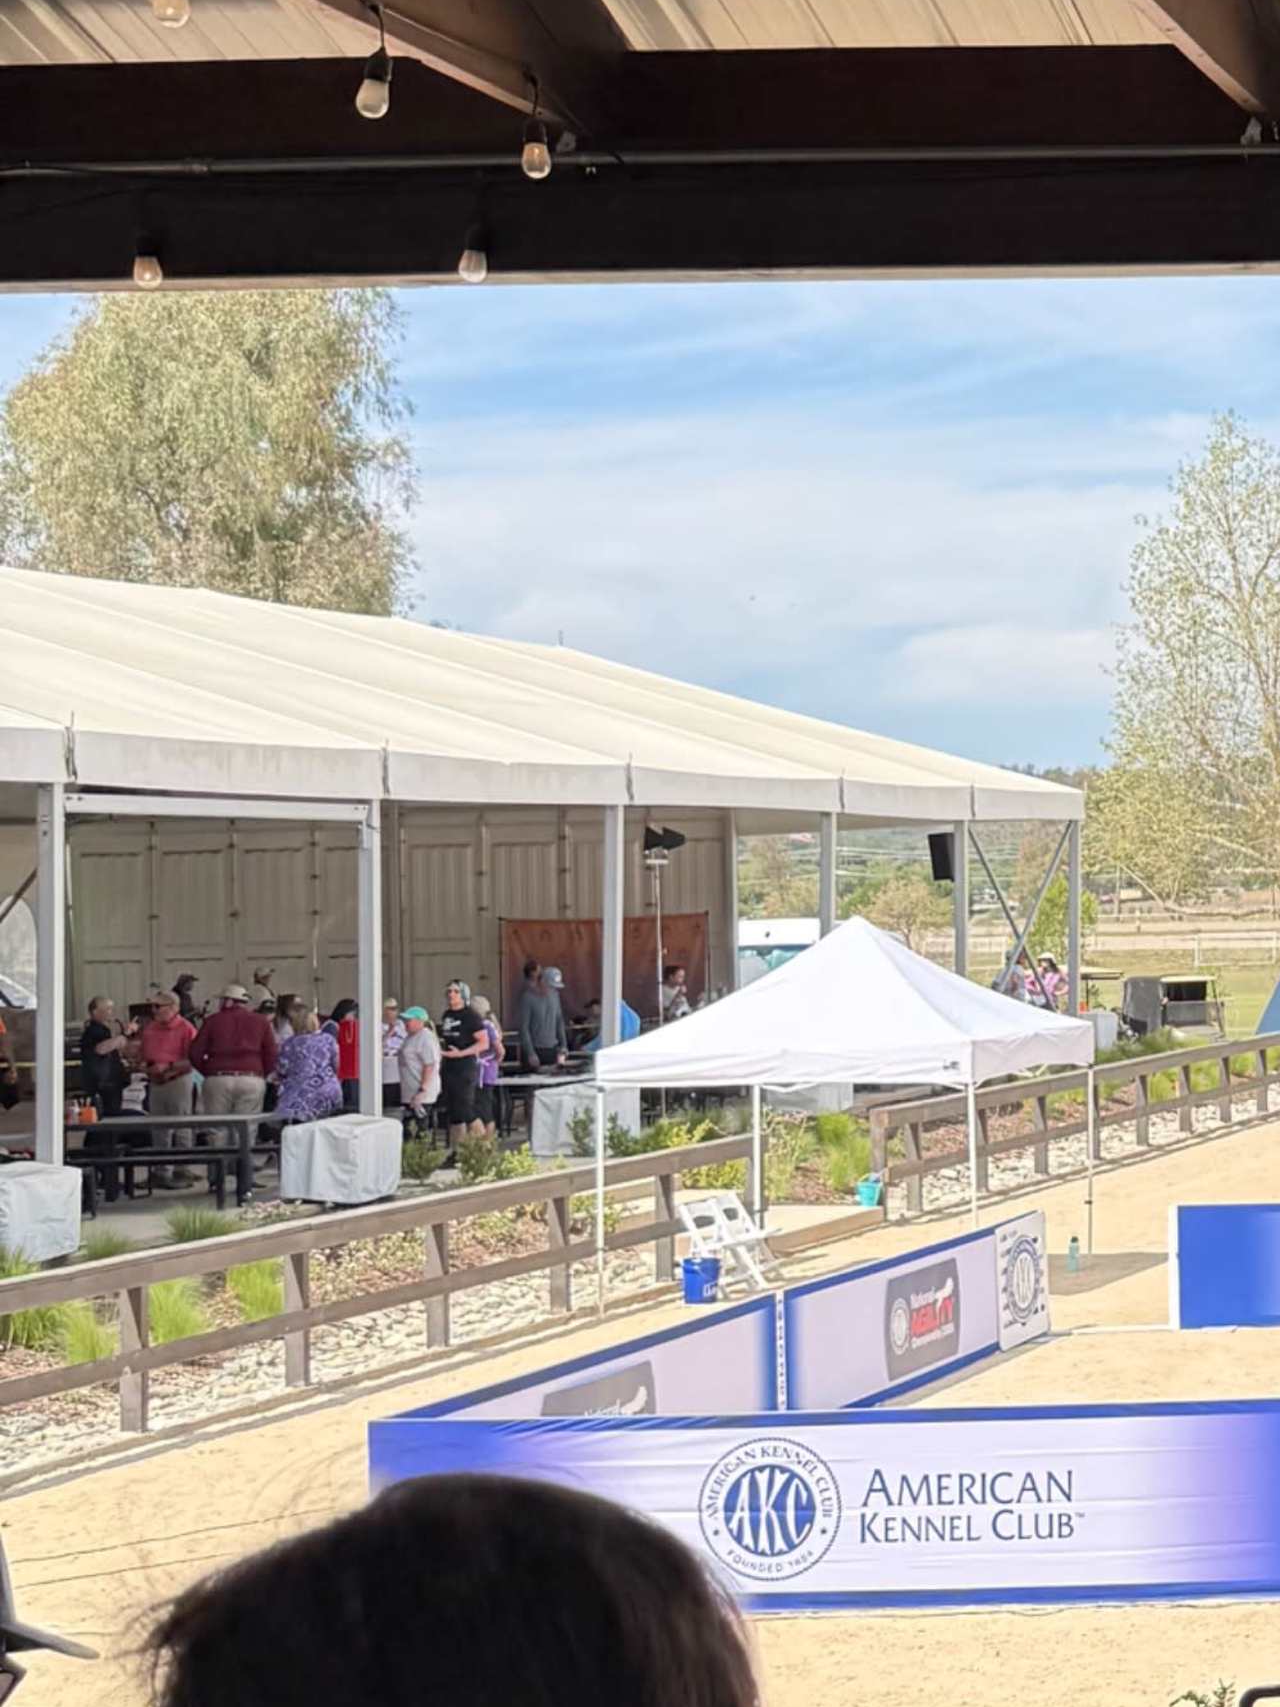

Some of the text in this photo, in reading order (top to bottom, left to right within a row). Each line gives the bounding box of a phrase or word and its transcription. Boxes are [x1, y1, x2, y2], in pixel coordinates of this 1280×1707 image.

[862, 1468, 1073, 1507] AMERICAN
[728, 1466, 814, 1557] AKC
[859, 1512, 981, 1544] KENNEL
